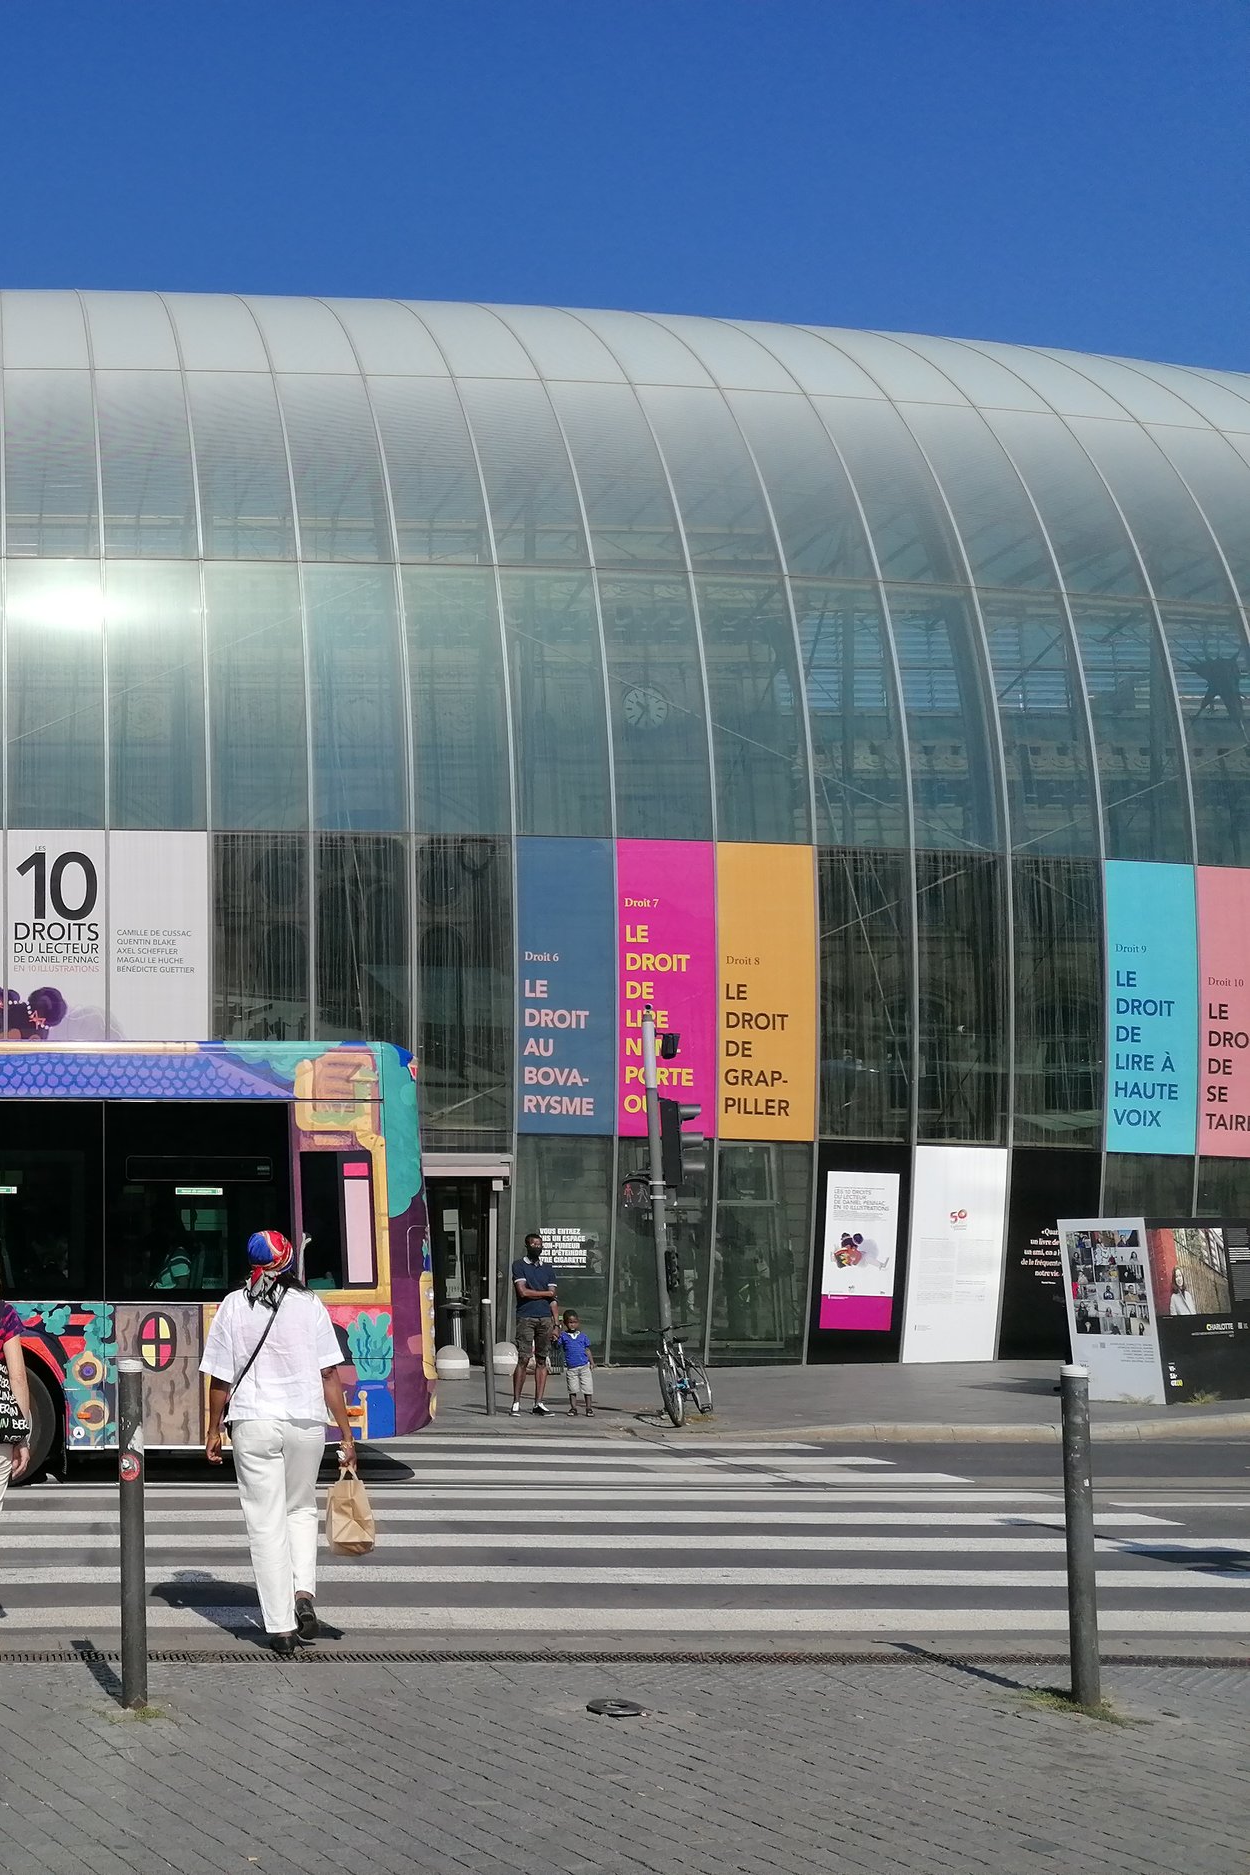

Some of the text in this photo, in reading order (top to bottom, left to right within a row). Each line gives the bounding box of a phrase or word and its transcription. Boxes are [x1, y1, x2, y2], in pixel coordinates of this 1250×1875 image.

[16, 851, 97, 921] 10
[624, 897, 659, 908] Droit 7
[14, 922, 99, 941] DROITS
[625, 924, 649, 943] LE
[14, 942, 99, 954] DU LECTEUR
[524, 951, 559, 962] Droit 6
[1115, 944, 1147, 953] Droit 9
[14, 955, 25, 963] DE
[28, 955, 59, 963] DANIEL
[625, 952, 690, 972] DROIT
[726, 955, 760, 966] Droit 8
[37, 965, 100, 973] ILLUSTRATIONS
[524, 979, 548, 998] LE
[1116, 970, 1137, 988] LE
[1208, 976, 1244, 987] Droit 10
[625, 981, 654, 1000] DE
[725, 983, 748, 1000] LE
[1116, 998, 1175, 1017] DROIT
[1208, 1003, 1229, 1020] LE
[524, 1008, 590, 1030] DROIT
[725, 1011, 789, 1031] DROIT
[1116, 1025, 1141, 1043] DE
[523, 1038, 554, 1057] AU
[725, 1040, 753, 1058] DE
[1115, 1051, 1176, 1073] LIRE À
[1208, 1058, 1233, 1076] DE
[524, 1066, 589, 1087] BOVA-
[724, 1068, 788, 1087] GRAP-
[1114, 1081, 1179, 1100] HAUTE
[1207, 1085, 1228, 1103] SE
[523, 1094, 594, 1116] RYSME
[724, 1096, 790, 1117] PILLER
[1113, 1108, 1162, 1128] VOIX
[1206, 1322, 1233, 1331] CHARLOTTE
